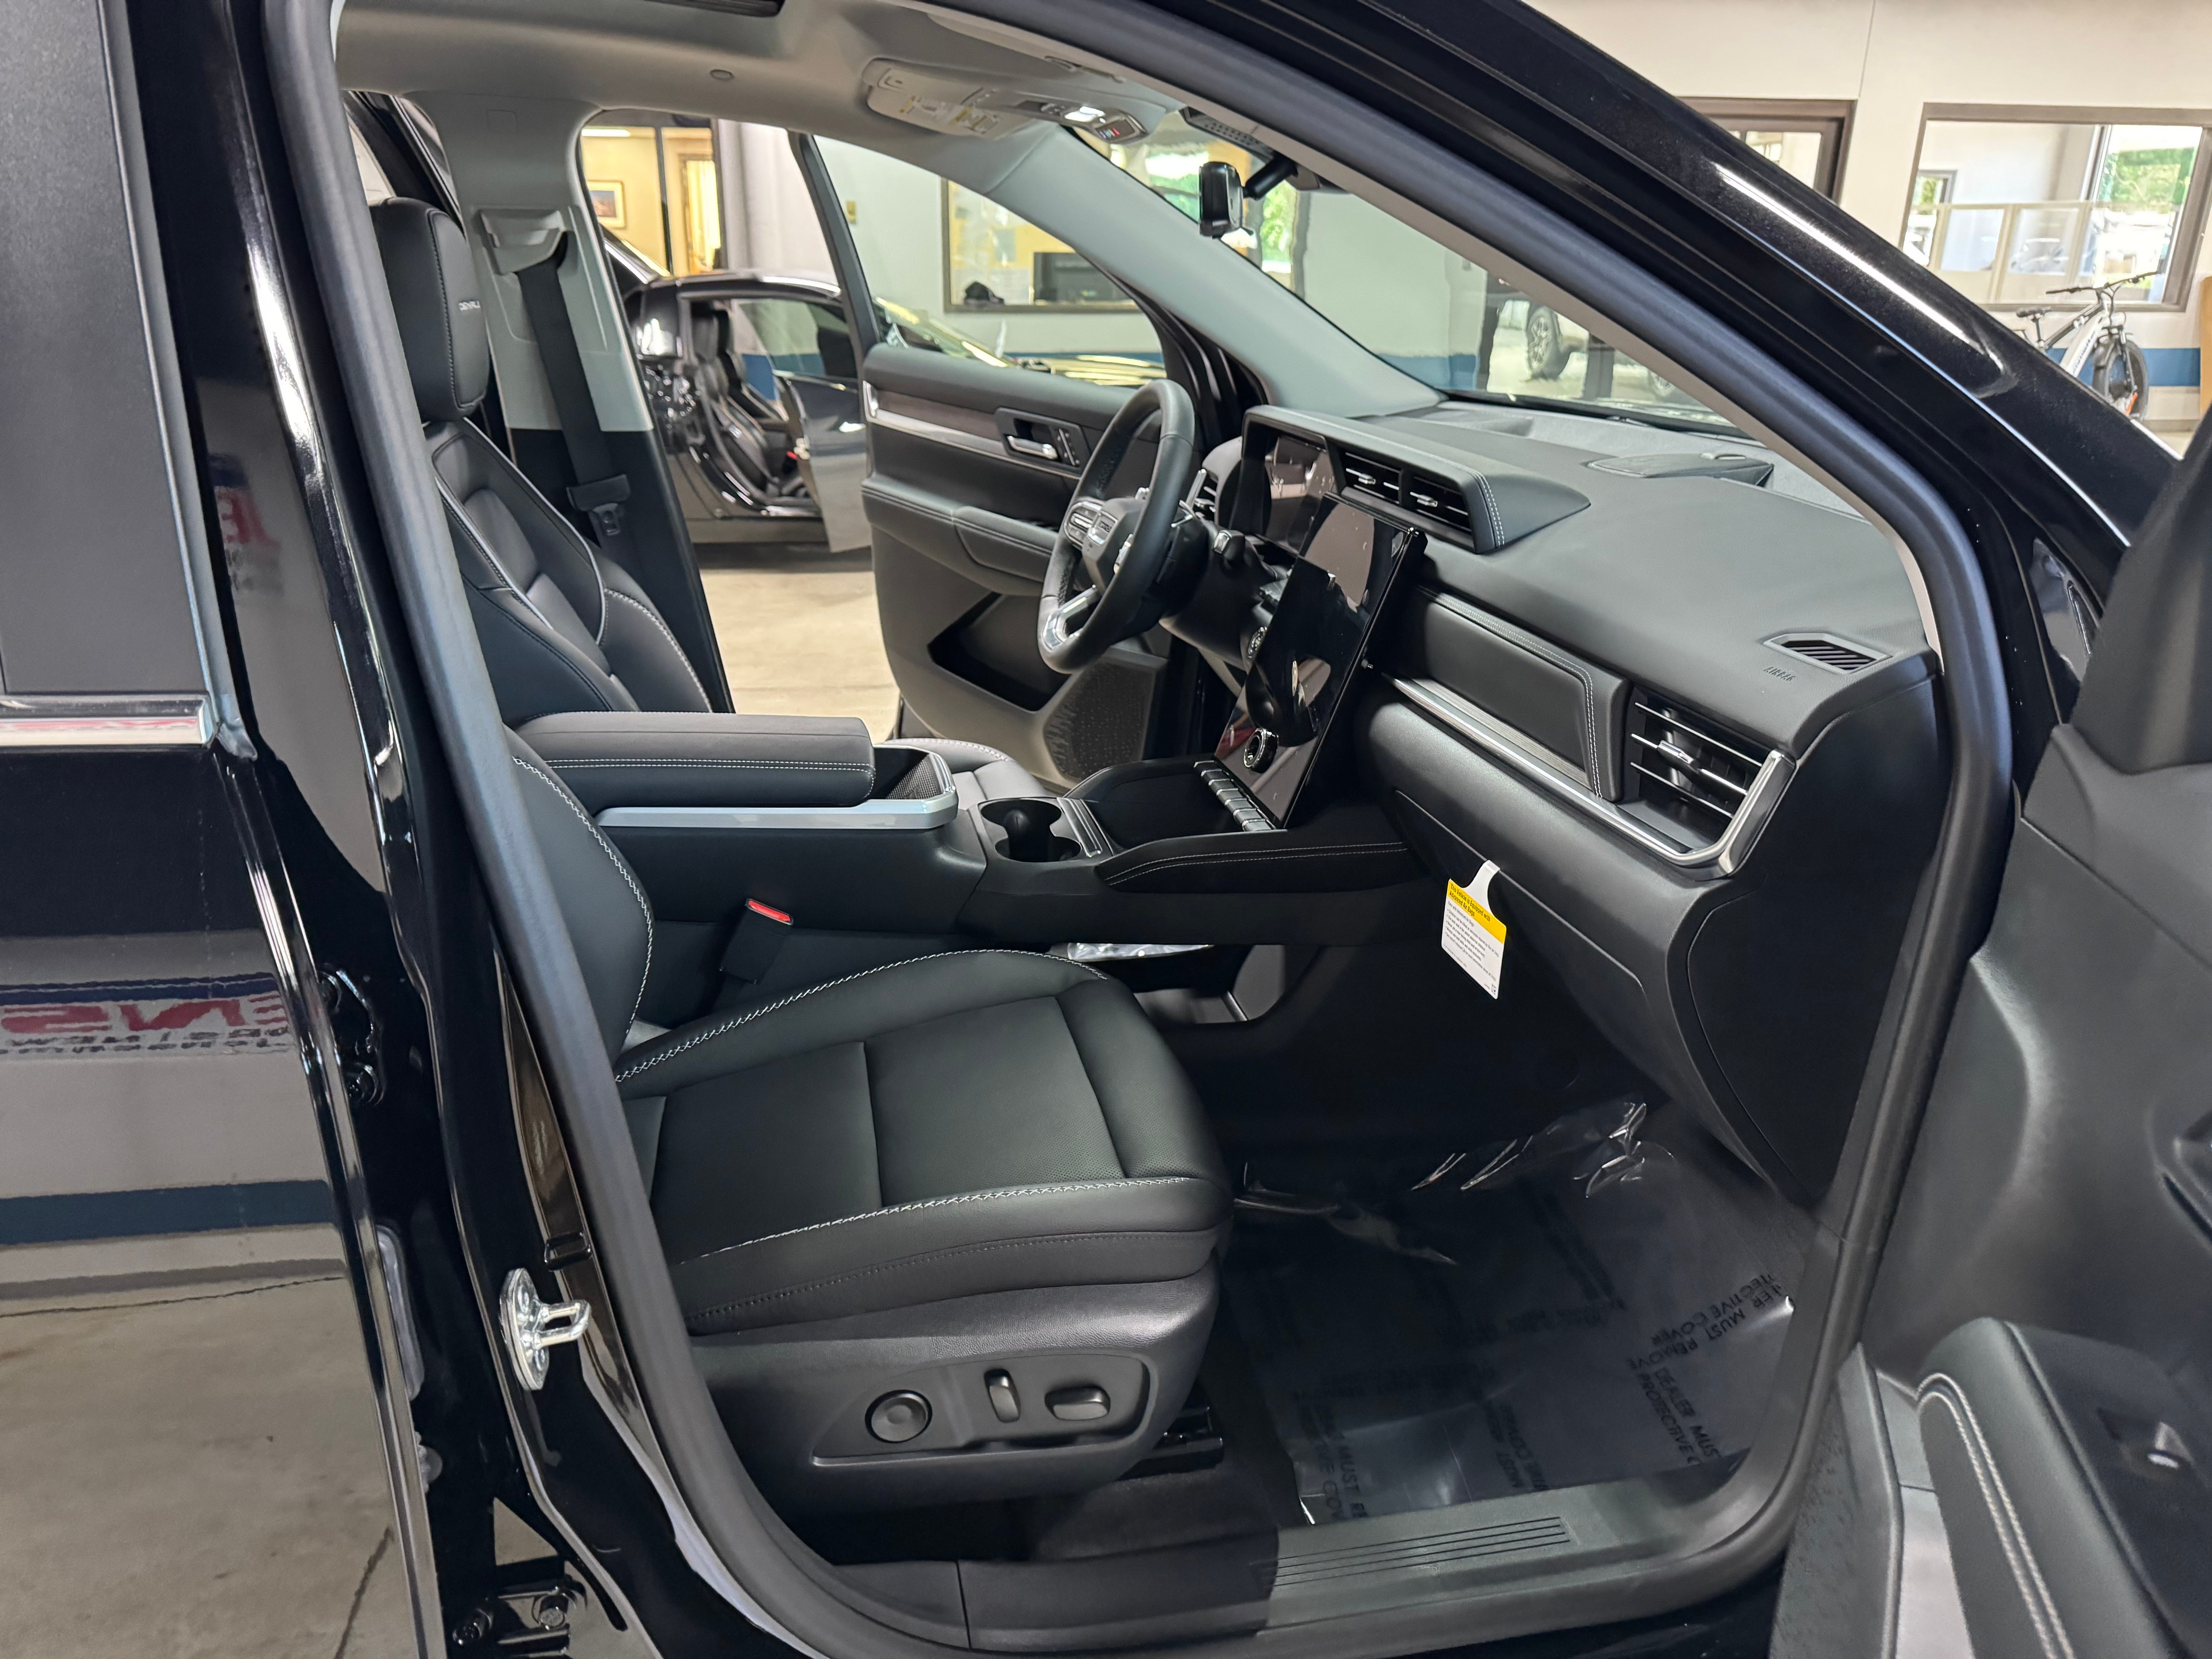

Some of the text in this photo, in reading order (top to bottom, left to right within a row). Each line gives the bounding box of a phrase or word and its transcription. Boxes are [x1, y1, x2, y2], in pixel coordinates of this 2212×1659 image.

[1449, 891, 1463, 905] Advanced
[1470, 900, 1484, 916] Equipped
[1651, 1311, 1707, 1346] COVER
[1704, 1308, 1746, 1341] MUST
[1629, 1338, 1698, 1370] REMOVE
